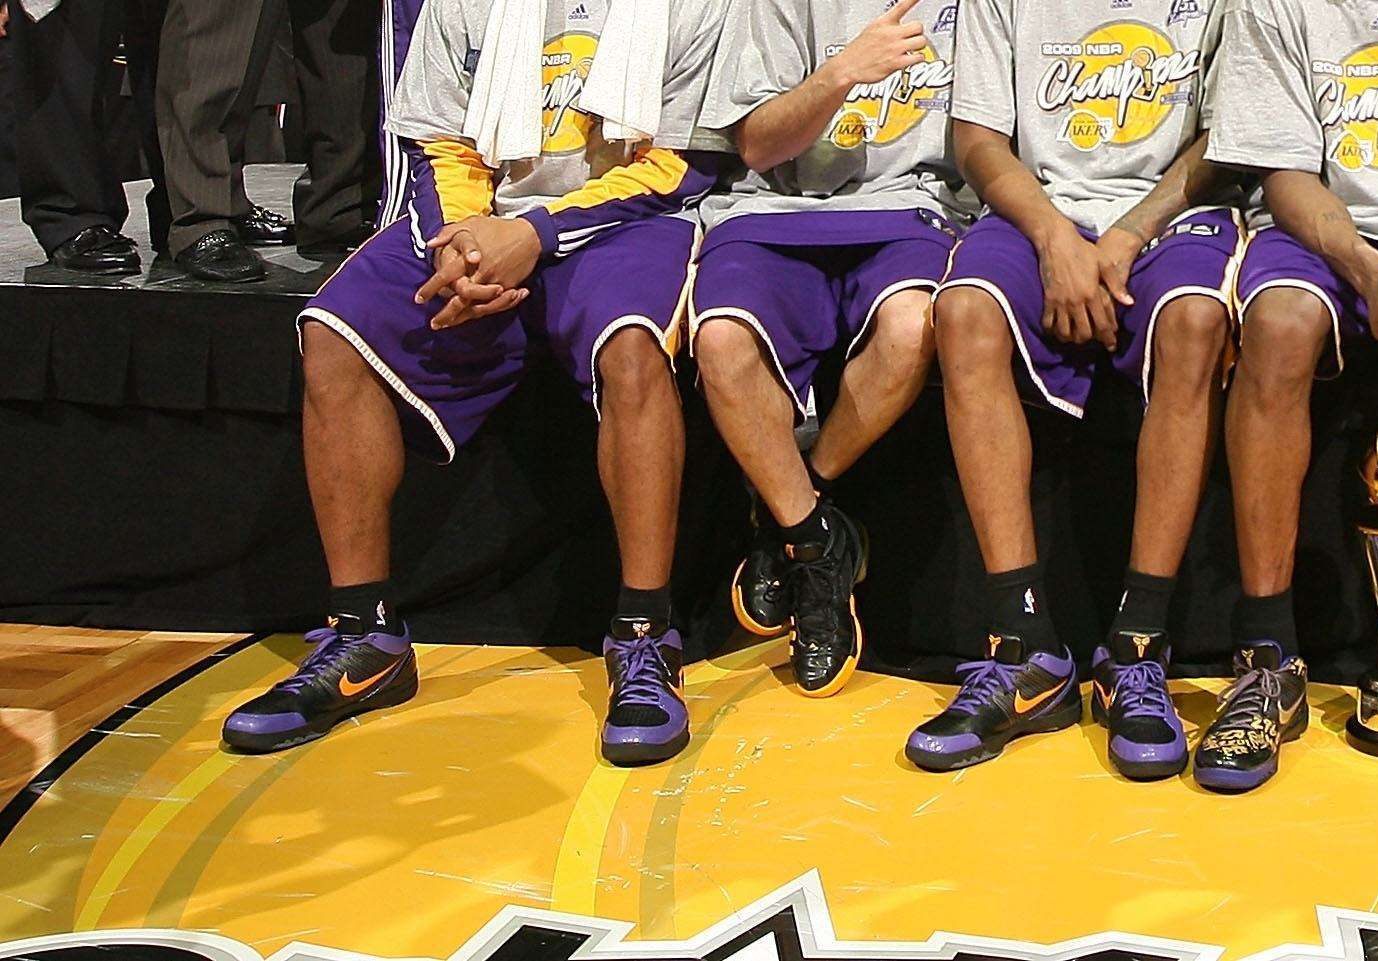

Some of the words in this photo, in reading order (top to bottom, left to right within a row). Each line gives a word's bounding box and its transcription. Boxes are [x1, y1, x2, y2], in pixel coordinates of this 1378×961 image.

[1041, 43, 1083, 56] 2009
[1086, 44, 1123, 56] NBA
[542, 53, 572, 67] NBA
[1036, 56, 1200, 128] Champions
